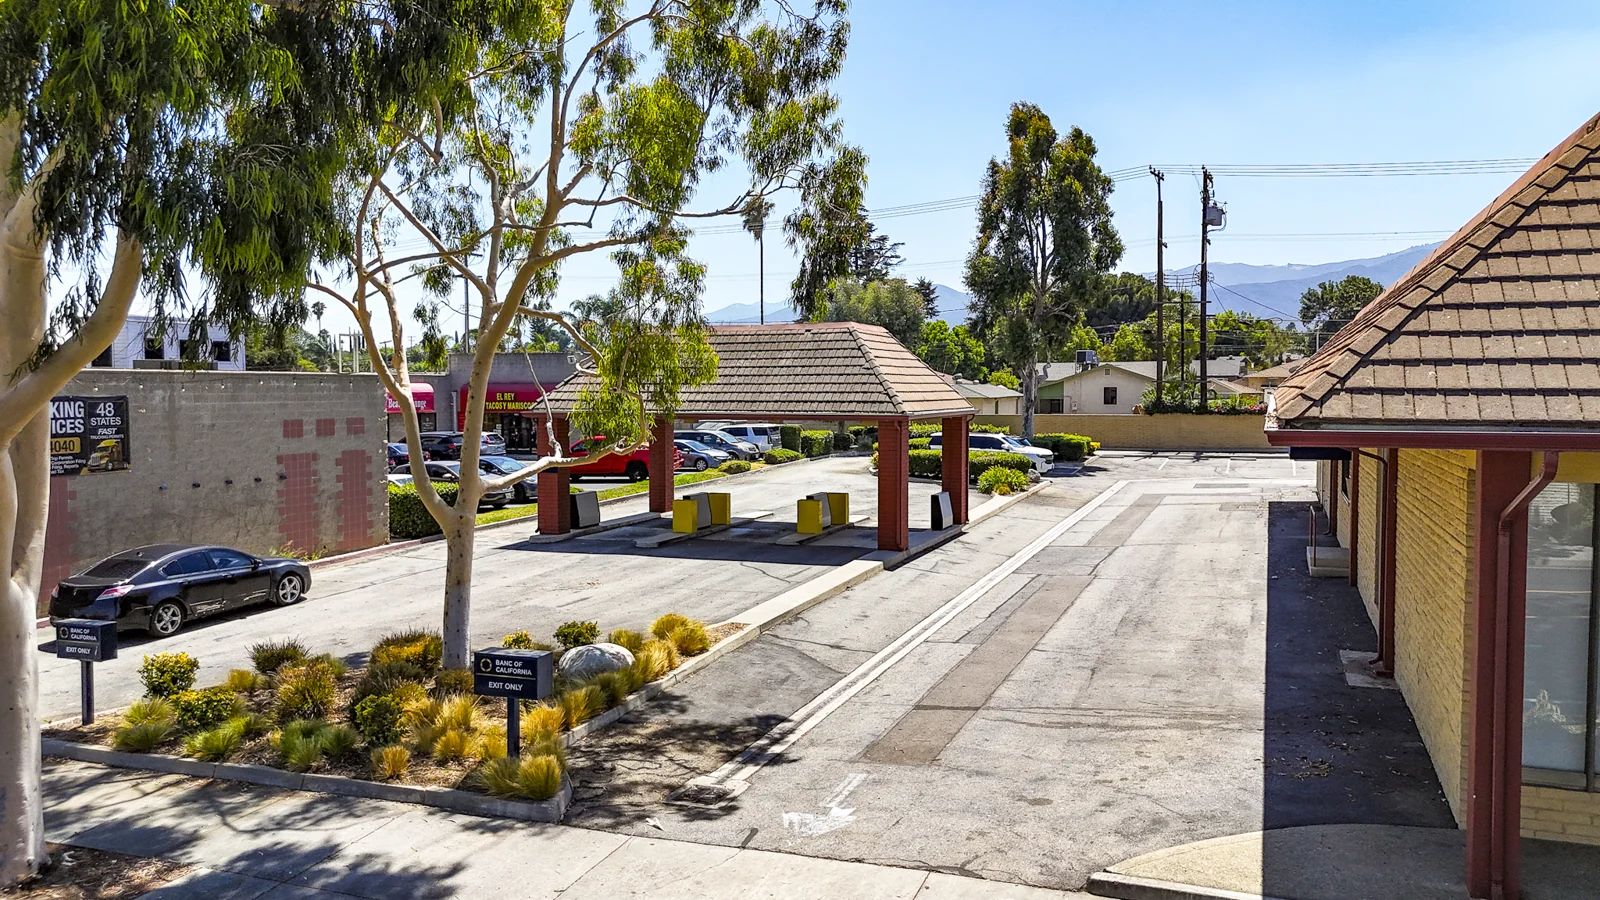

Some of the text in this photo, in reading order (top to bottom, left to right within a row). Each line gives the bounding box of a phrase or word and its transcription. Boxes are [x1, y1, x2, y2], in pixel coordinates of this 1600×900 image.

[496, 392, 515, 401] EL REY
[388, 398, 400, 408] Bea
[485, 401, 502, 410] TACOS
[502, 401, 507, 410] Y
[50, 401, 84, 419] KING
[96, 402, 114, 417] 48
[90, 417, 121, 426] STATES
[51, 419, 84, 434] ICES
[98, 427, 117, 435] FAST
[495, 659, 513, 667] BANC
[495, 667, 532, 675] CALIFORNIA
[488, 681, 523, 691] EXIT ONLY
